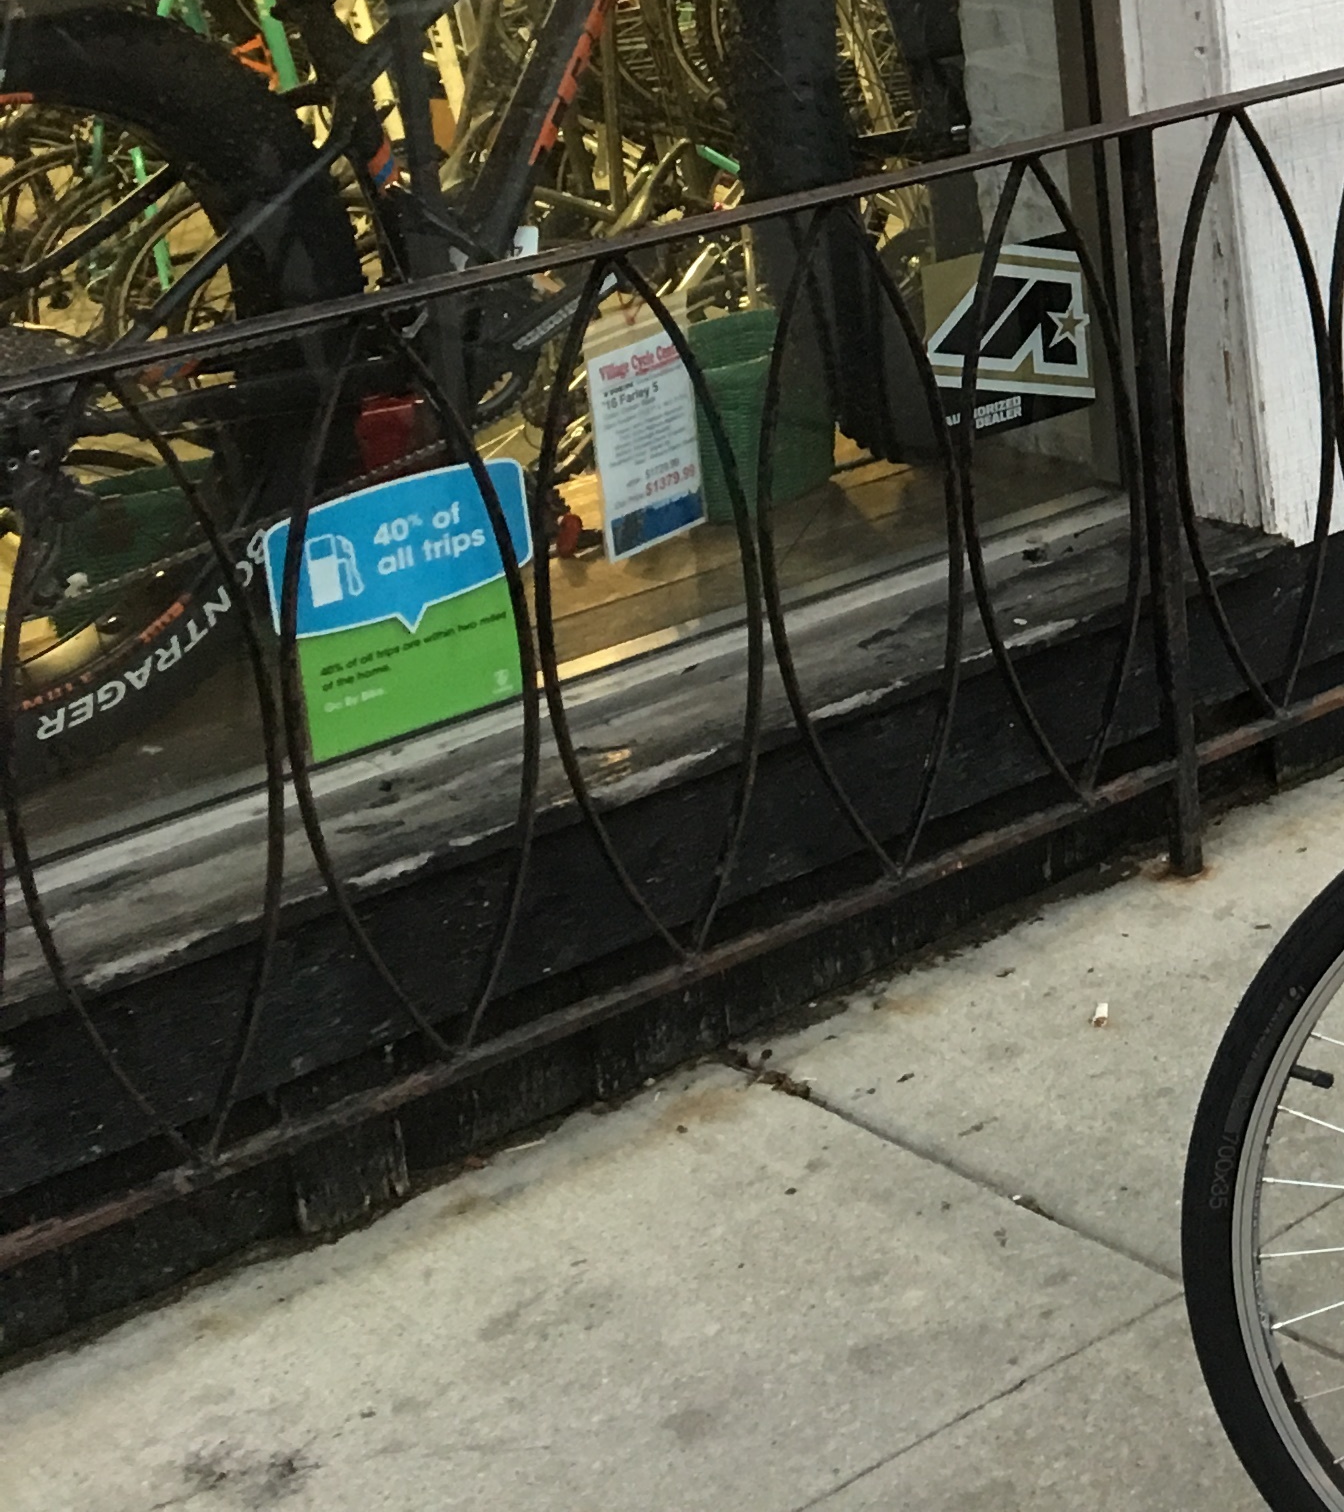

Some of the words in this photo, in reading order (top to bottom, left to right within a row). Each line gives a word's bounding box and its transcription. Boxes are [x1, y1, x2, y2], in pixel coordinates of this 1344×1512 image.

[945, 395, 1023, 427] AUORIZED
[975, 406, 1023, 430] DEALER
[373, 514, 423, 546] 40%
[431, 500, 460, 530] of
[376, 545, 414, 576] all
[422, 527, 486, 562] trips
[345, 656, 358, 670] of
[376, 643, 400, 660] trips
[1209, 1133, 1240, 1210] 700x35
